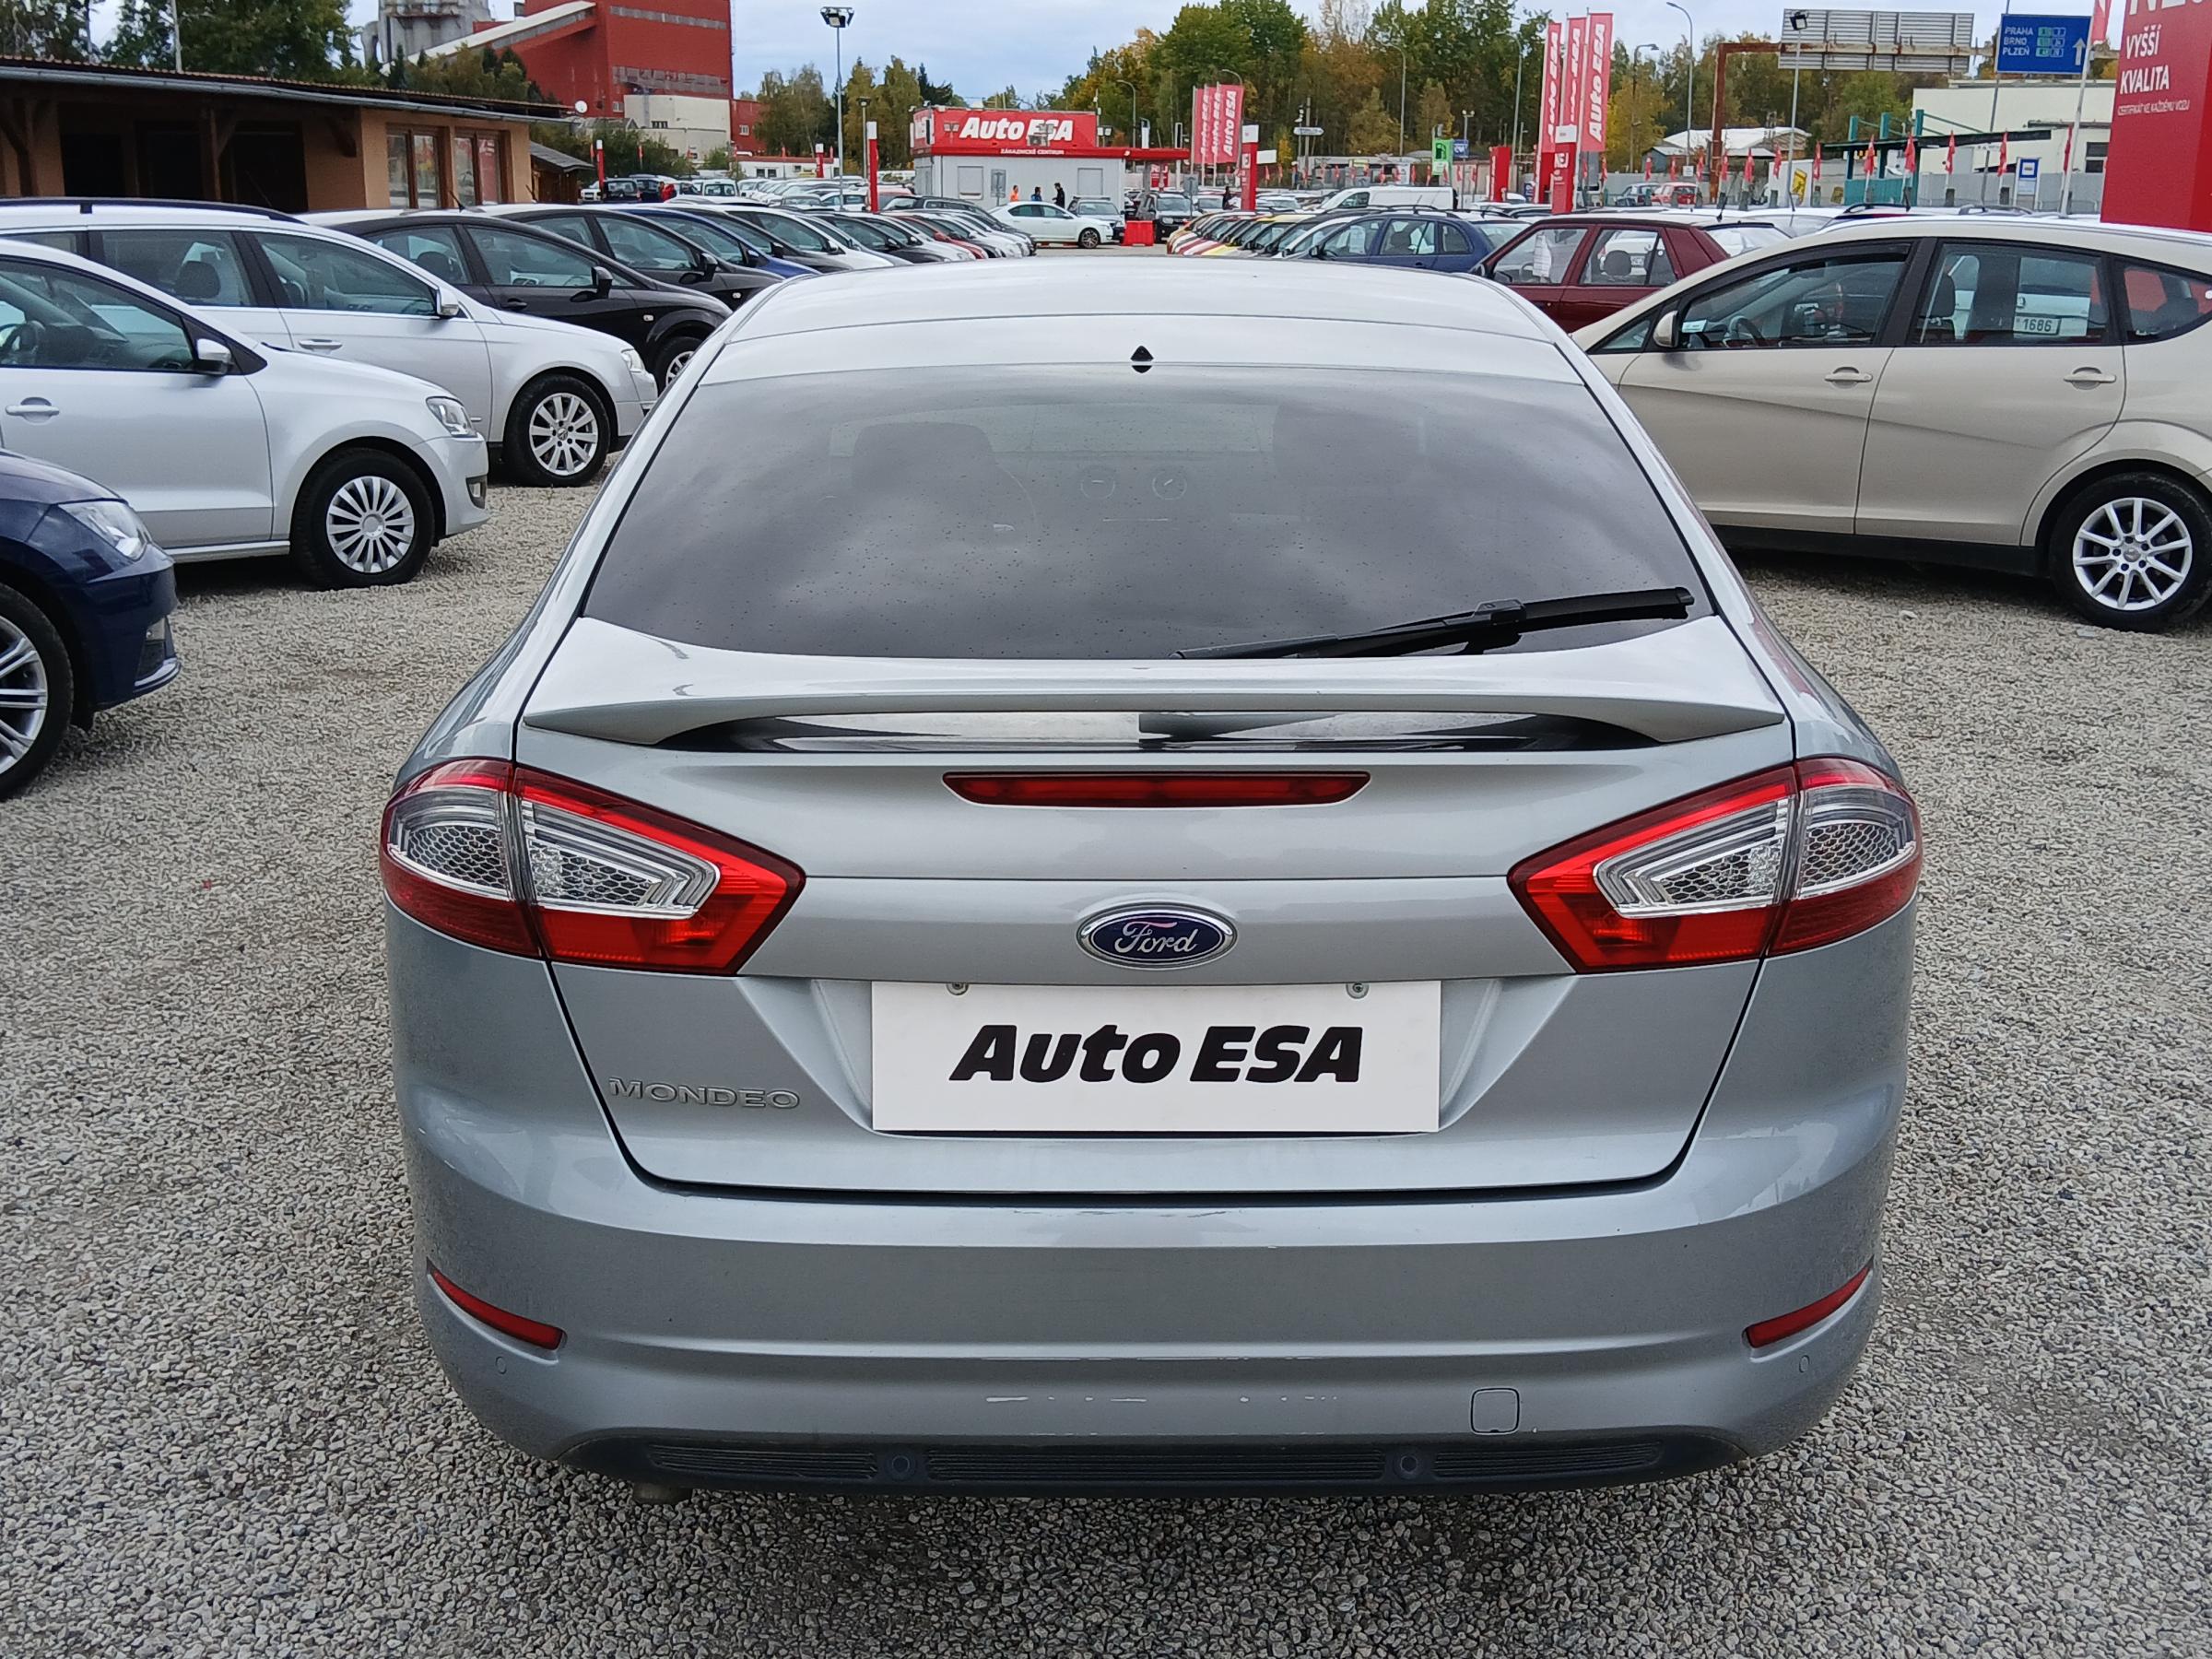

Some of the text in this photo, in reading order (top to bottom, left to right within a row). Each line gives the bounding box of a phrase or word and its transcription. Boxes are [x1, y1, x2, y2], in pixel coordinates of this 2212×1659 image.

[2003, 37, 2028, 46] BRNO
[2004, 27, 2033, 36] PRAHA
[2126, 24, 2162, 60] VYŠŠÍ
[2120, 65, 2170, 95] KVALITA
[959, 117, 1025, 140] Auto
[1223, 90, 1237, 157] Auto ESA
[2022, 318, 2053, 333] 1686
[1113, 922, 1198, 955] Ford
[948, 1024, 1363, 1083] Auto ESA
[608, 1077, 801, 1109] MONDEO
